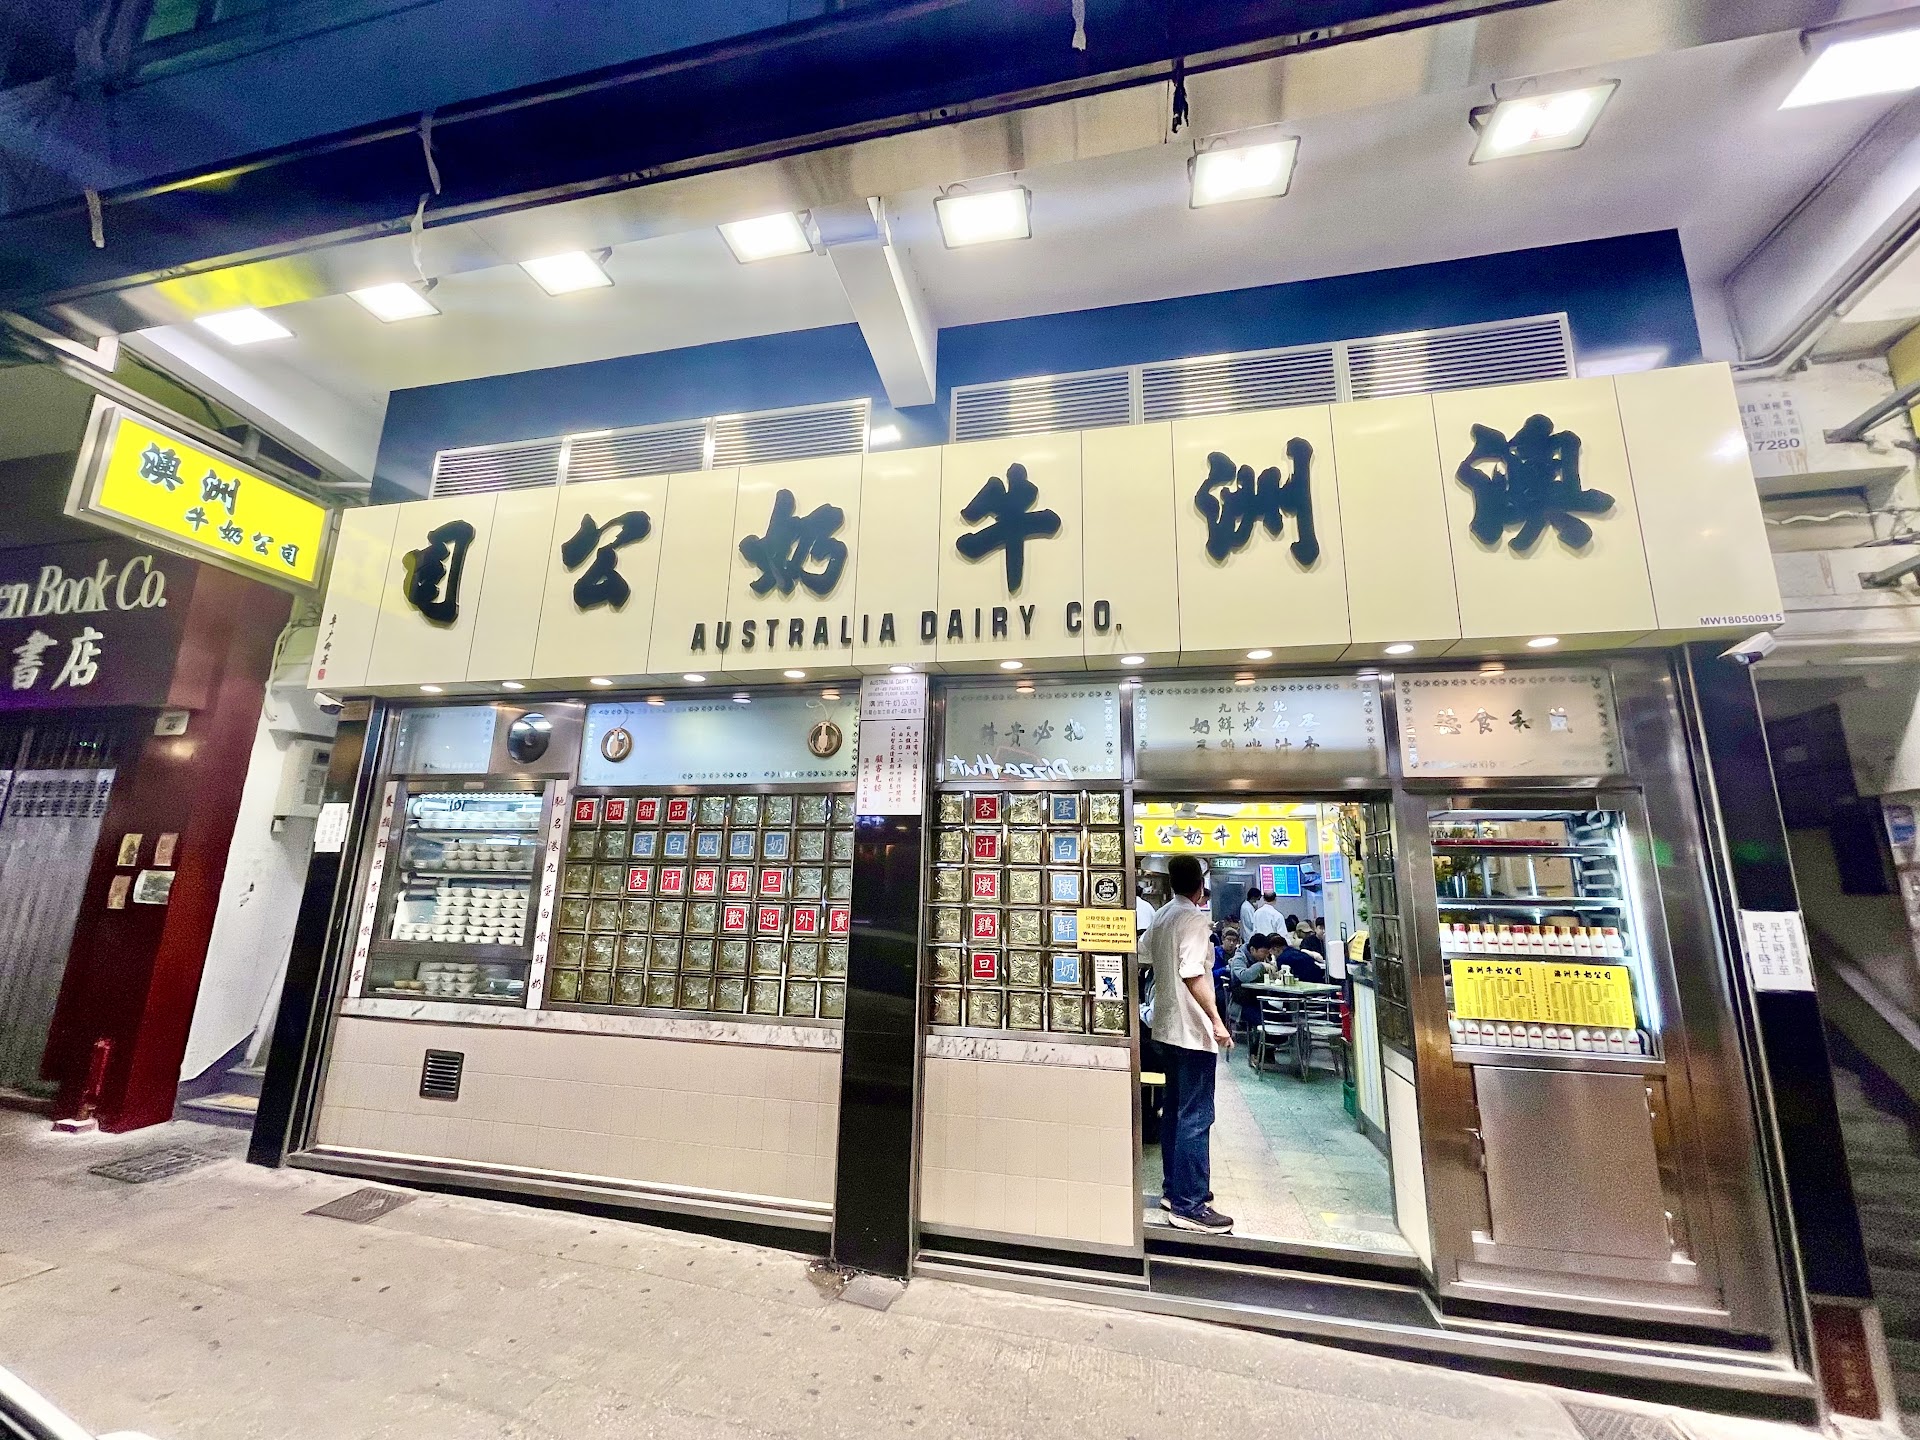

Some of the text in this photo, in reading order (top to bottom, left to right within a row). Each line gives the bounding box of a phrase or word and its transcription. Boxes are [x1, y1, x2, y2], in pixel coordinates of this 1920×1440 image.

[140, 442, 242, 515] 澳洲
[184, 505, 301, 568] 牛奶公司
[27, 558, 117, 616] Book
[116, 555, 167, 610] Co.
[691, 599, 1123, 652] AUSTRALIA DAIRY CO.
[1700, 613, 1783, 625] MW180500915
[12, 626, 104, 690] 書店
[869, 698, 918, 708] 澳洲牛奶公司
[636, 835, 785, 853] 蛋白燉鮮奶
[1055, 800, 1076, 980] 蛋白燉鮮奶
[726, 909, 850, 930] 歡迎外賣
